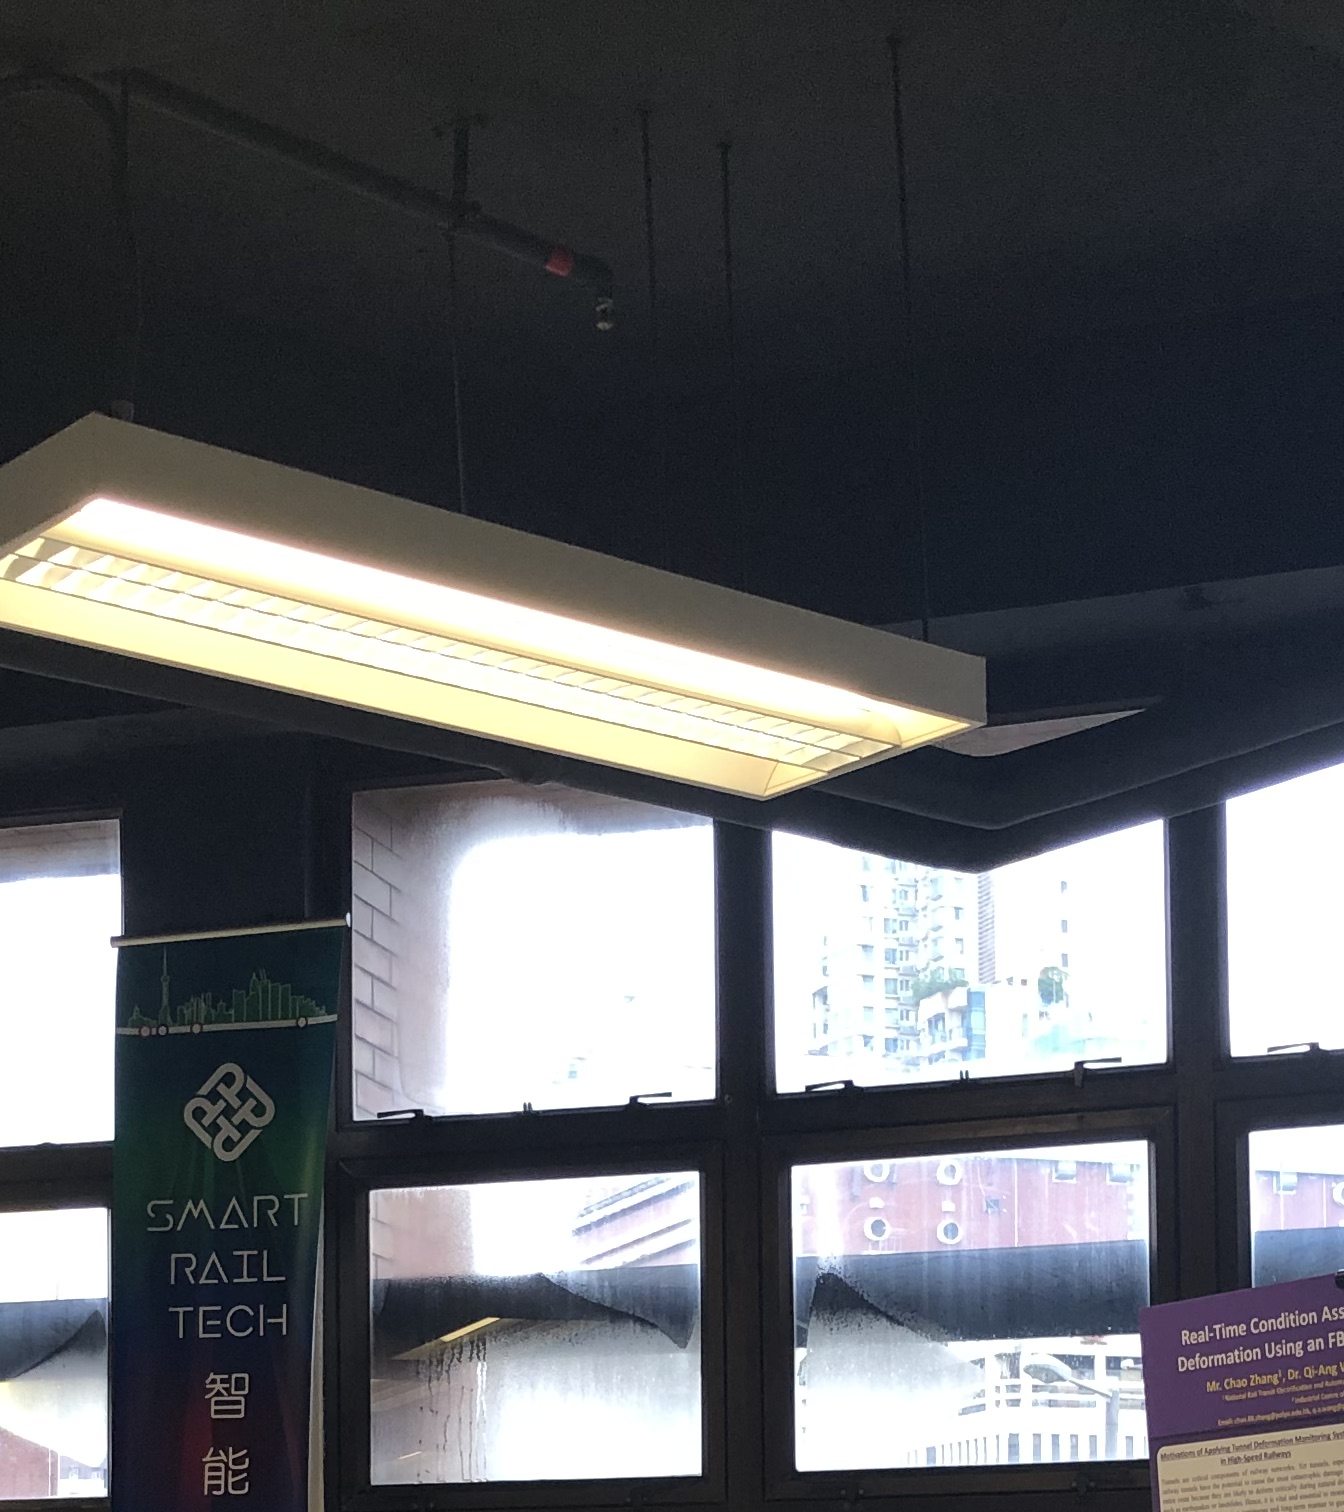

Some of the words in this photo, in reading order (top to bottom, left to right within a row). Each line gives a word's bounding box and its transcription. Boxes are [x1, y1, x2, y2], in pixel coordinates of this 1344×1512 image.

[147, 1193, 308, 1231] SMART
[171, 1250, 286, 1284] RAIL
[169, 1304, 287, 1338] TECH
[1181, 1324, 1246, 1345] Real-Time
[1250, 1310, 1317, 1334] Condition
[1178, 1346, 1261, 1372] Deformation
[1265, 1339, 1304, 1358] Using
[1307, 1338, 1324, 1351] an
[1207, 1381, 1222, 1392] Mr.
[1224, 1377, 1247, 1390] Chao
[1288, 1369, 1301, 1380] Dr.
[1304, 1364, 1338, 1378] Qi-Ang
[1197, 1448, 1203, 1456] of
[1204, 1446, 1230, 1455] Applying
[1232, 1442, 1252, 1451] Tunnel
[1254, 1438, 1293, 1449] Deformation
[1295, 1434, 1331, 1443] Monitoring
[1228, 1453, 1262, 1464] High-Speed
[1263, 1451, 1291, 1460] Railways
